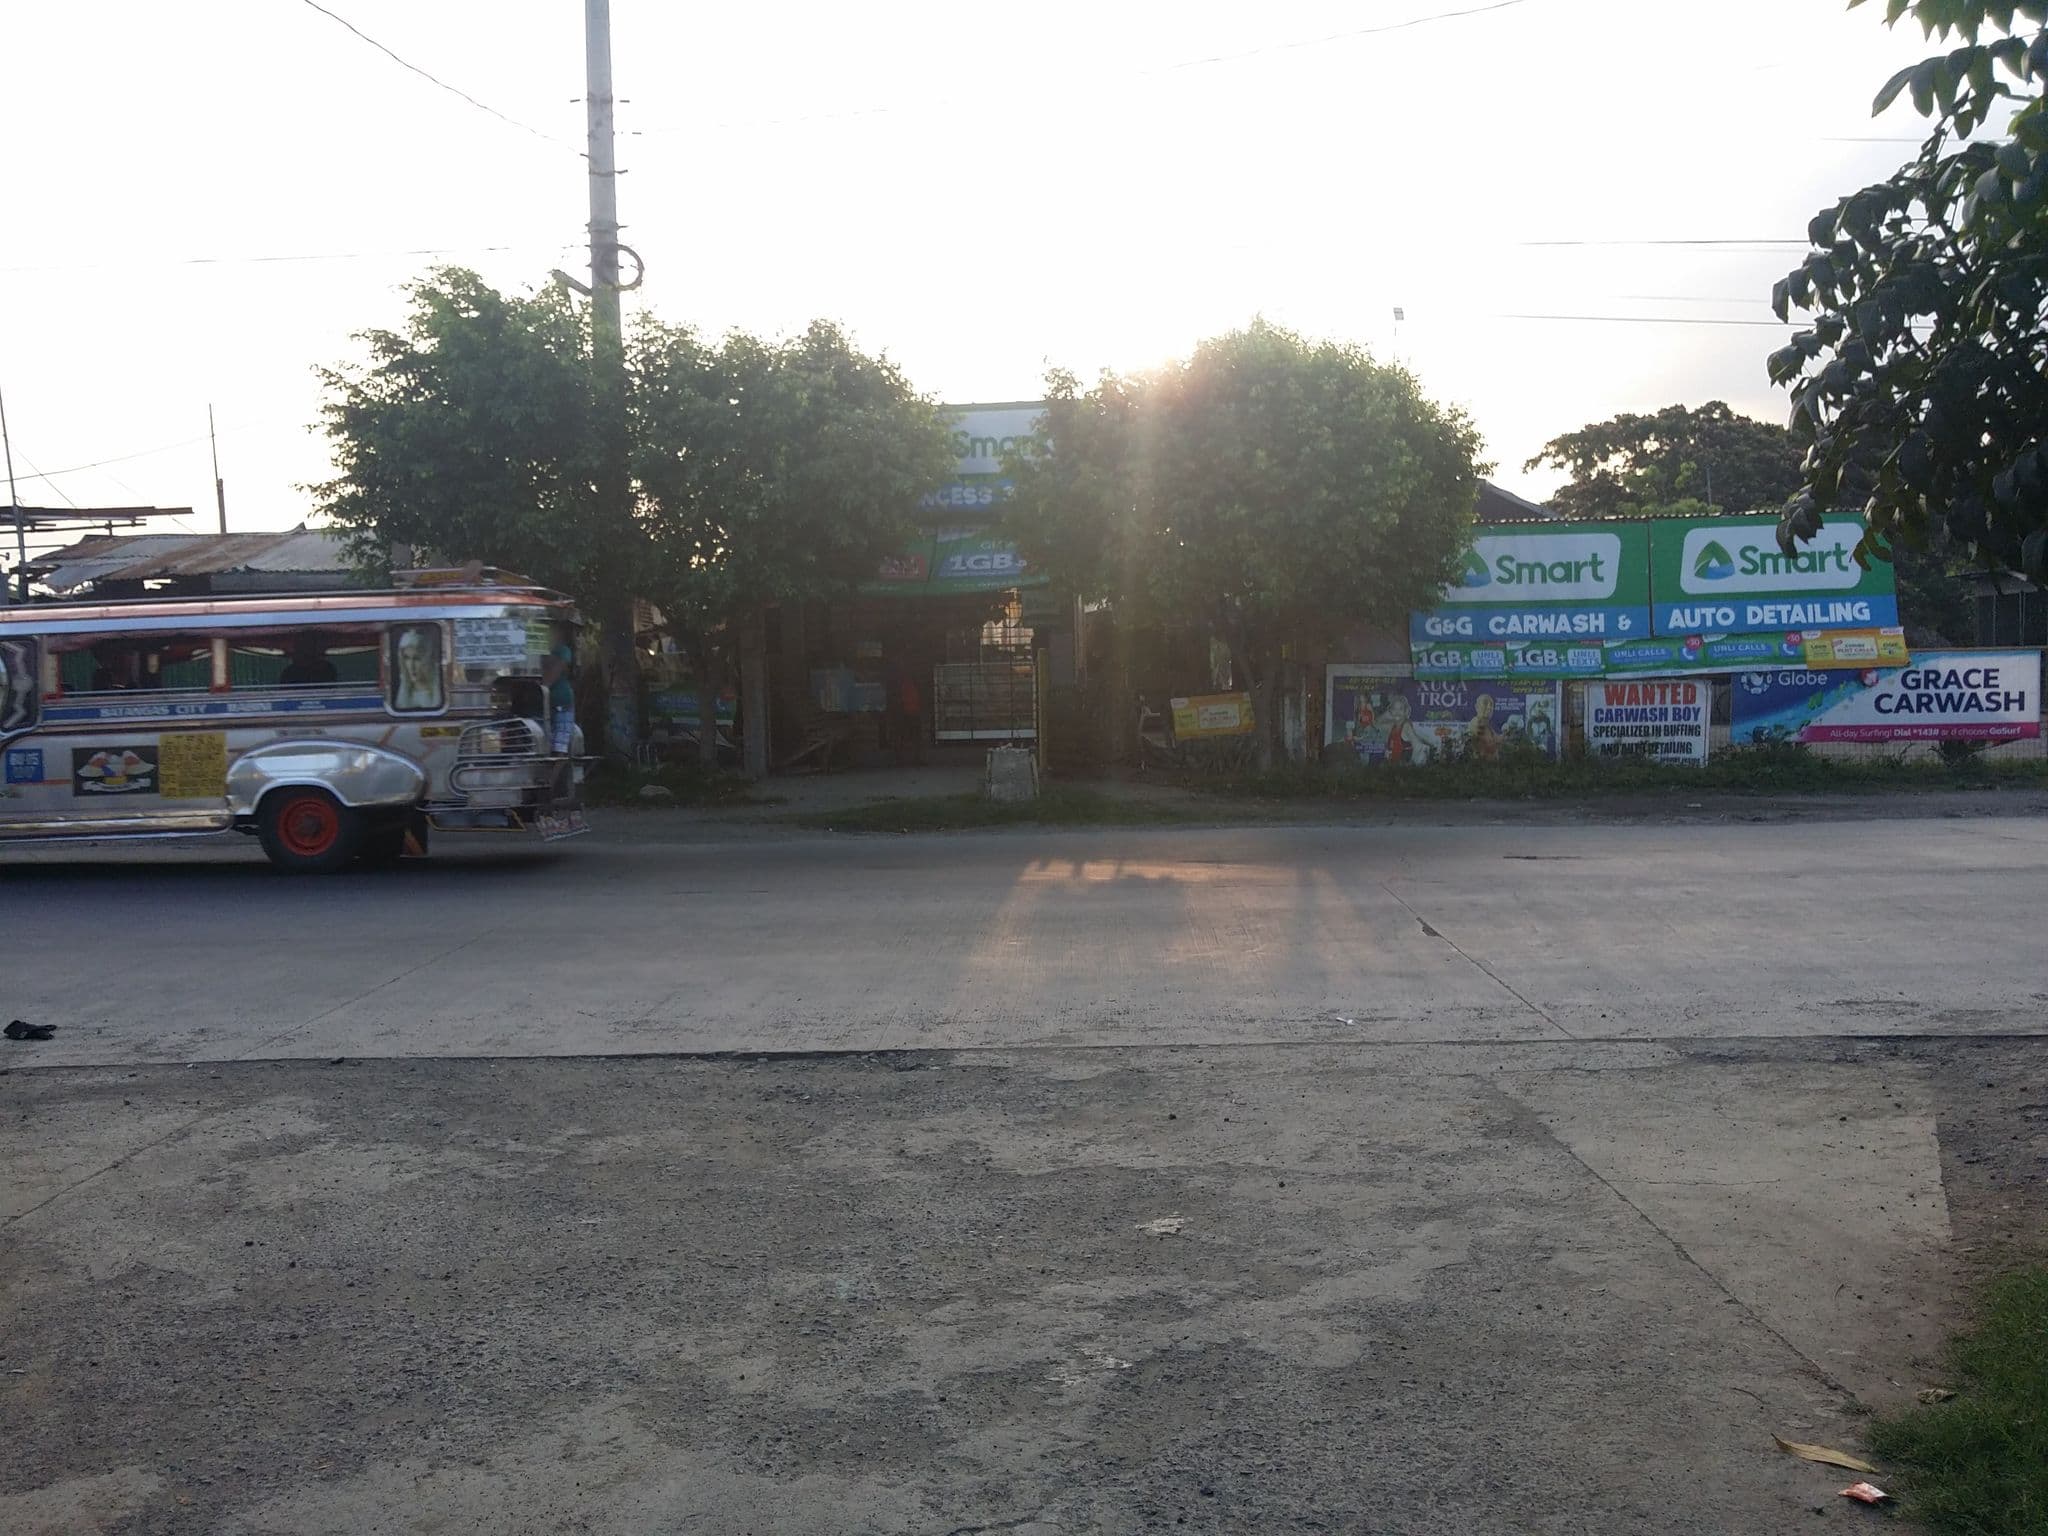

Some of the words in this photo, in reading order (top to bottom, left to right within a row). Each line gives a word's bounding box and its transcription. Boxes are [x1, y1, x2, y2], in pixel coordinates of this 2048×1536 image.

[1739, 541, 1849, 577] Smart
[1496, 552, 1605, 585] Smart
[1424, 615, 1474, 636] G&G
[1488, 612, 1605, 635] CARWASH
[1617, 614, 1632, 631] &
[1668, 607, 1736, 630] AUTO
[1746, 601, 1871, 625] DETAILING
[1614, 649, 1636, 659] UNLI
[1637, 648, 1666, 658] CALLS
[1713, 644, 1737, 653] UNLI
[1738, 643, 1766, 652] CALLS
[1778, 670, 1829, 687] Globe
[1900, 668, 2000, 691] GRACE
[1417, 691, 1468, 708] TROL
[1603, 682, 1697, 706] WANTED
[174, 704, 208, 715] CITY
[1874, 691, 2027, 716] CARWASH
[1593, 708, 1669, 723] CARWASH
[1672, 707, 1702, 722] BOY
[1663, 724, 1701, 737] BUFFING
[1894, 728, 1911, 737] Dial
[1958, 727, 1988, 736] choose
[1649, 741, 1693, 755] DETAILING
